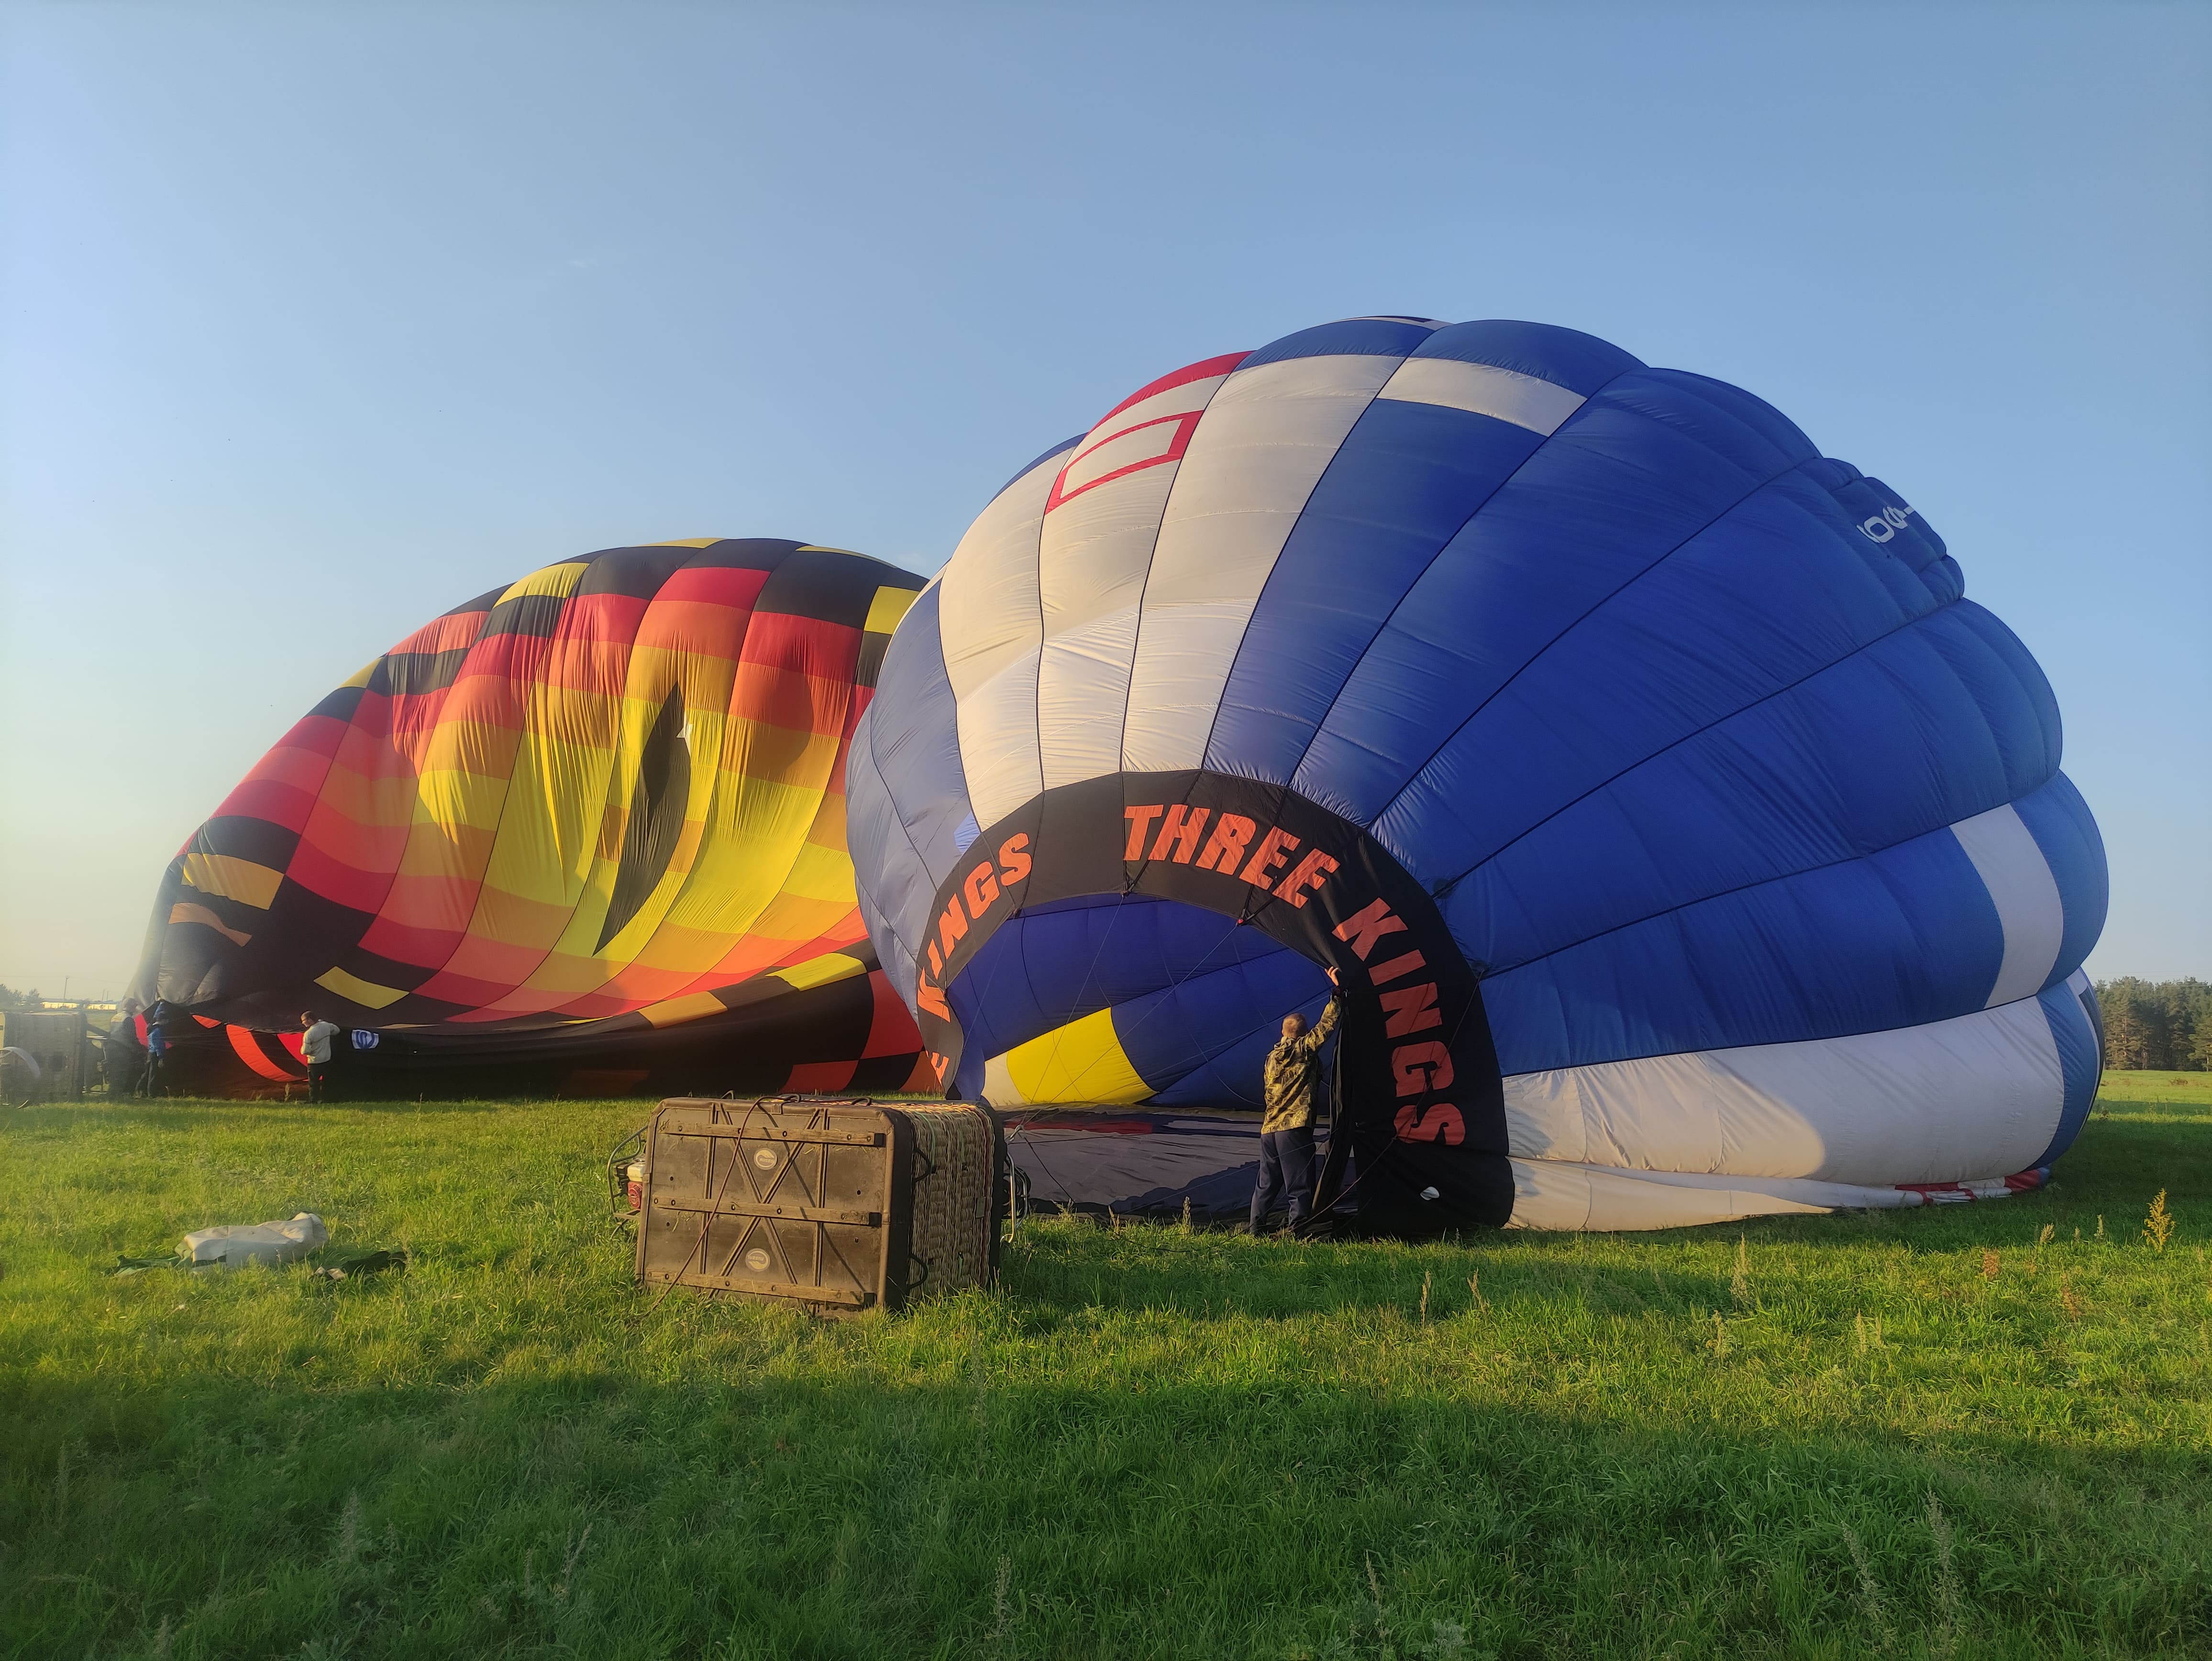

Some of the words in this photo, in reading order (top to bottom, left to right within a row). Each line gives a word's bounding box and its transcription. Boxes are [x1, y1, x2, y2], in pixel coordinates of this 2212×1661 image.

[917, 832, 1032, 1023] KINGS
[1123, 804, 1340, 909] THREE
[1331, 897, 1466, 1146] KINGS
